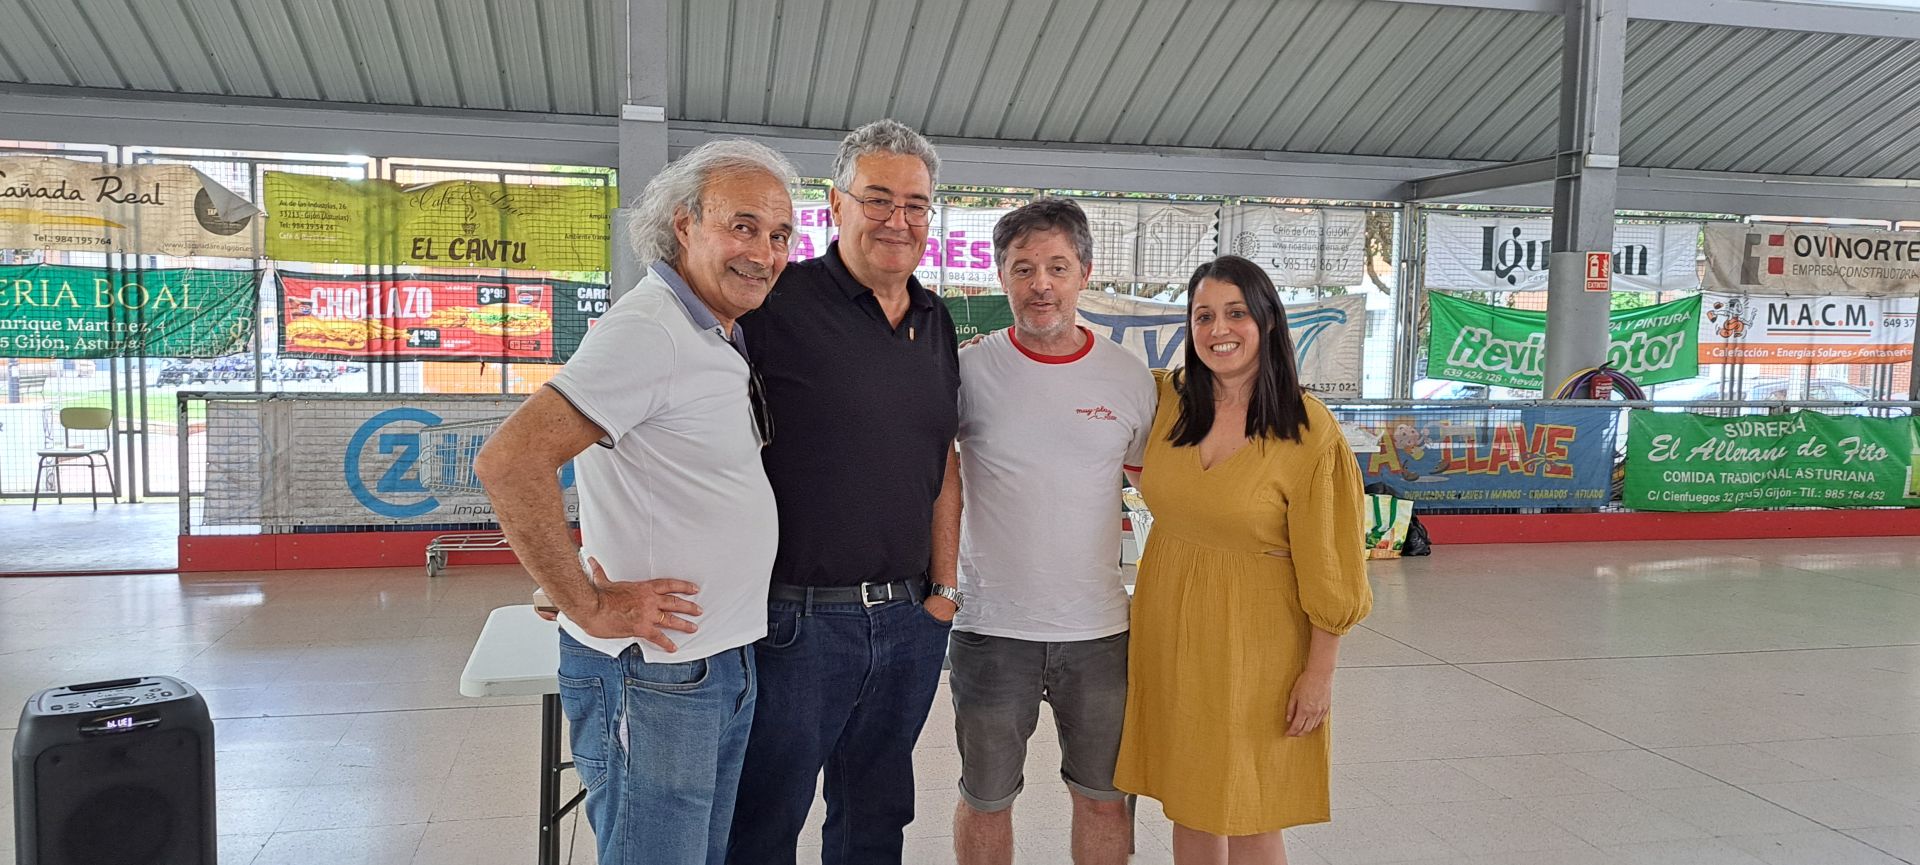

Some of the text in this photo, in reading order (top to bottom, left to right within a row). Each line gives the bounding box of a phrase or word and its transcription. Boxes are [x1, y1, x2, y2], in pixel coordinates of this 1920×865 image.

[91, 176, 164, 205] Real
[55, 235, 73, 243] 984
[76, 236, 93, 244] 195
[95, 237, 112, 245] 764
[1794, 234, 1920, 262] OVINORTE
[411, 238, 526, 263] EL CANTU
[1283, 258, 1348, 271] 985 14 86 17
[94, 278, 200, 309] BOAL
[311, 285, 433, 321] CHOLLAZO
[577, 300, 592, 311] LA
[1625, 319, 1635, 331] Y
[1633, 311, 1692, 331] PINTURA
[1767, 303, 1875, 327] M.A.C.M.
[1883, 319, 1901, 328] 649
[15, 334, 69, 351] Gijón,
[1712, 347, 1769, 359] Calefacción
[1776, 347, 1816, 360] Energías
[1817, 348, 1852, 359] Solares
[1443, 368, 1463, 378] 639
[1464, 371, 1483, 380] 424
[1485, 374, 1502, 383] 128
[1440, 419, 1577, 479] LLAVE
[1648, 434, 1681, 462] El
[1797, 436, 1828, 458] de
[1838, 436, 1888, 464] Fito
[1663, 467, 1875, 484] COMIDA TRADICINAL ASTURIANA
[1447, 490, 1457, 500] DE
[1491, 490, 1522, 499] MANDOS
[1647, 490, 1660, 501] C/
[1663, 490, 1720, 505] Cienfuegos
[1722, 492, 1735, 502] 32
[1765, 487, 1792, 499] Gijón
[1824, 489, 1845, 499] 985
[1847, 490, 1865, 499] 164
[1866, 491, 1886, 500] 452
